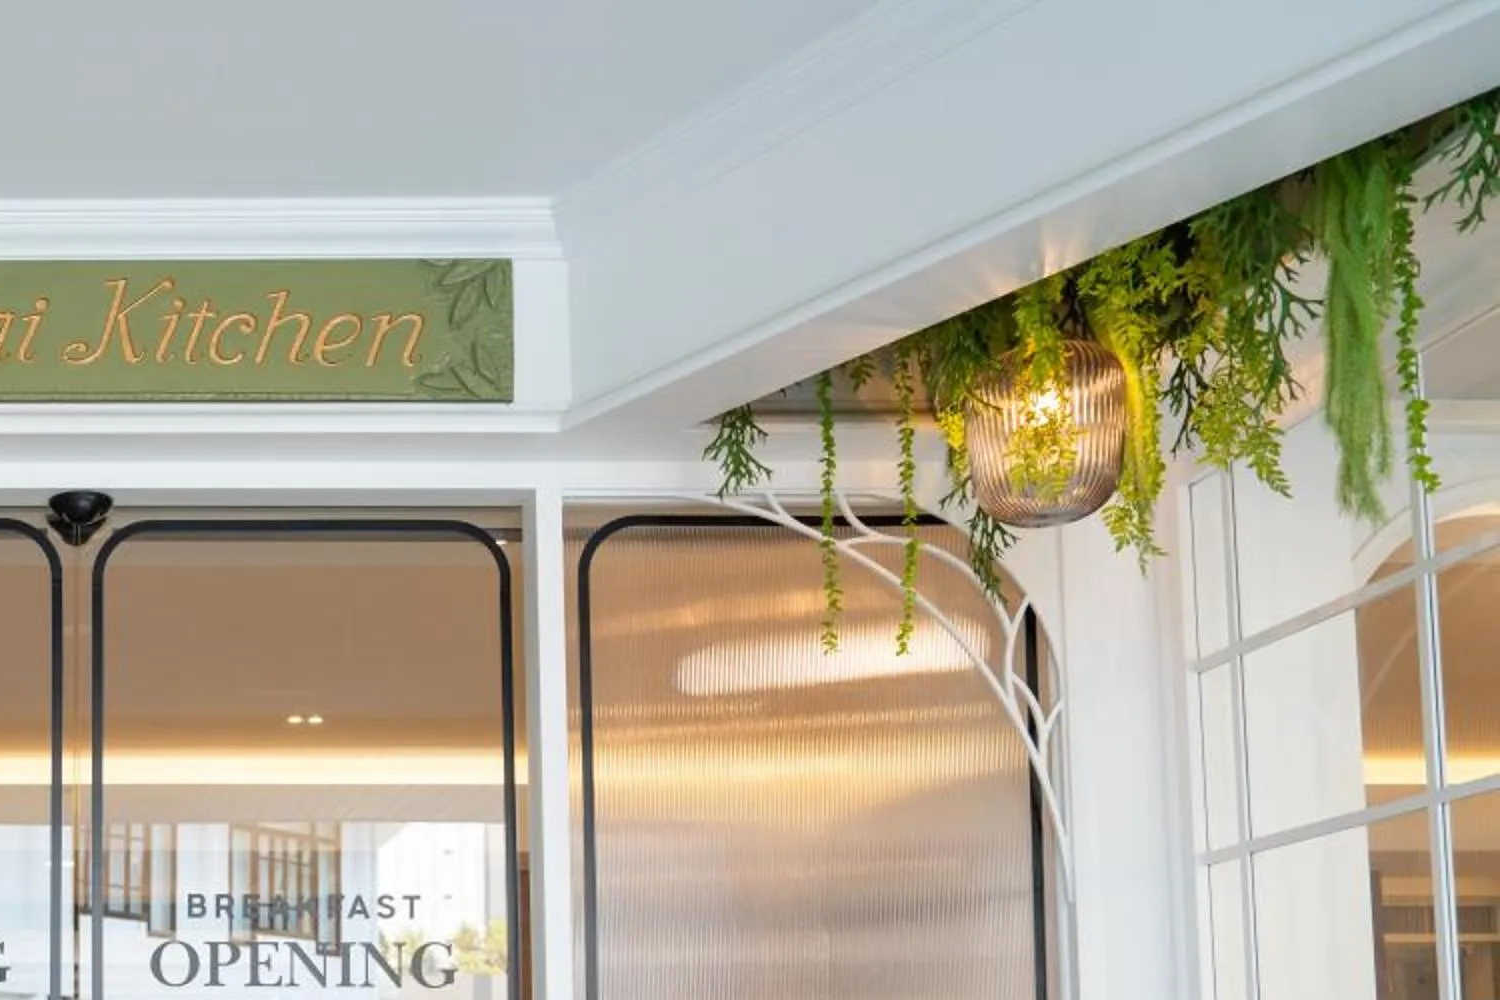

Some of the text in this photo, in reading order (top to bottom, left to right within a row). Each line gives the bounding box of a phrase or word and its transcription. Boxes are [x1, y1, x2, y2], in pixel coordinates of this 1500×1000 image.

[62, 276, 426, 367] Kitchen
[186, 892, 422, 920] BREAKFAST
[149, 940, 459, 989] OPENING
